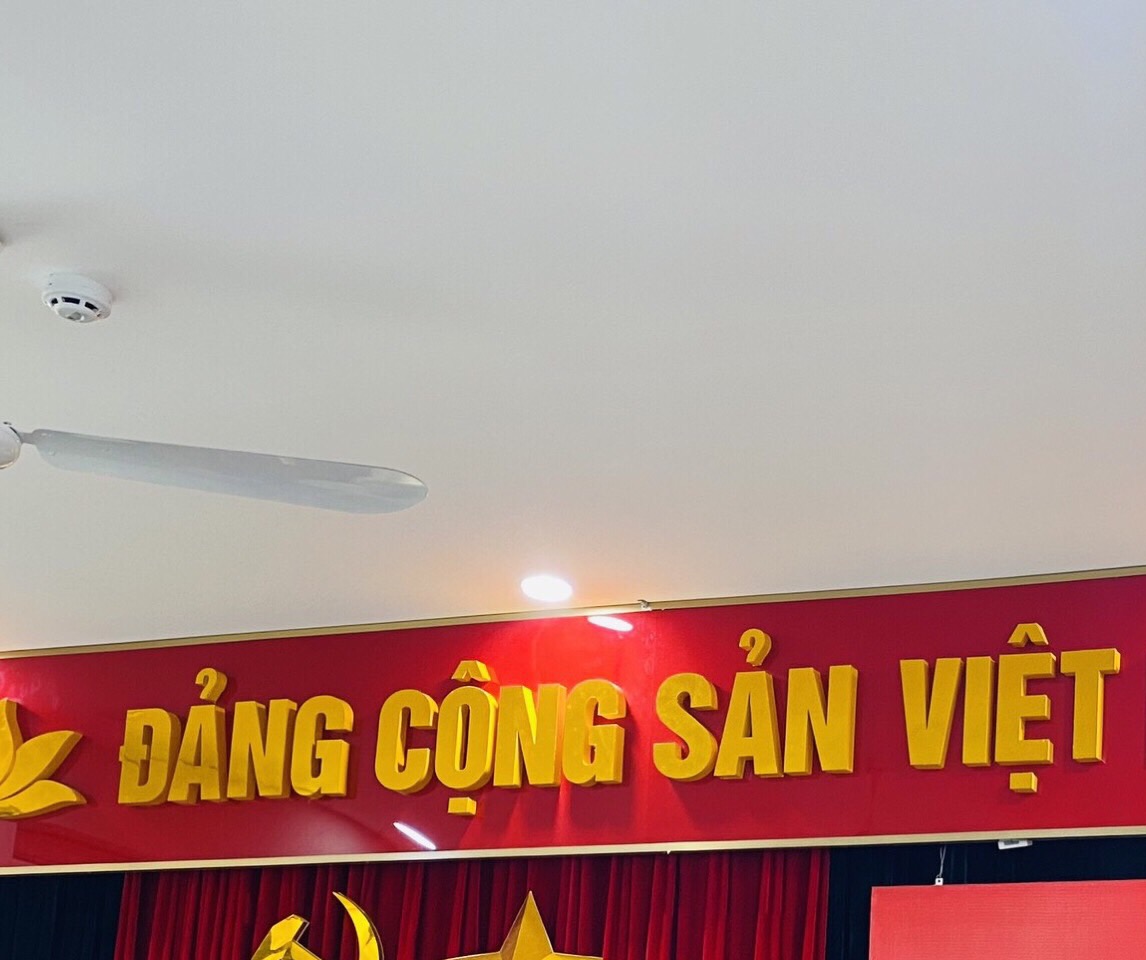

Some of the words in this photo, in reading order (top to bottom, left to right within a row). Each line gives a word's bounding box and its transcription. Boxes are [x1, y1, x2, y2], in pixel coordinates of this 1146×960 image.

[117, 667, 354, 806] ĐẢNG
[376, 662, 624, 814] CỘNG
[653, 628, 858, 777] SẢN
[901, 623, 1120, 793] VIỆT
